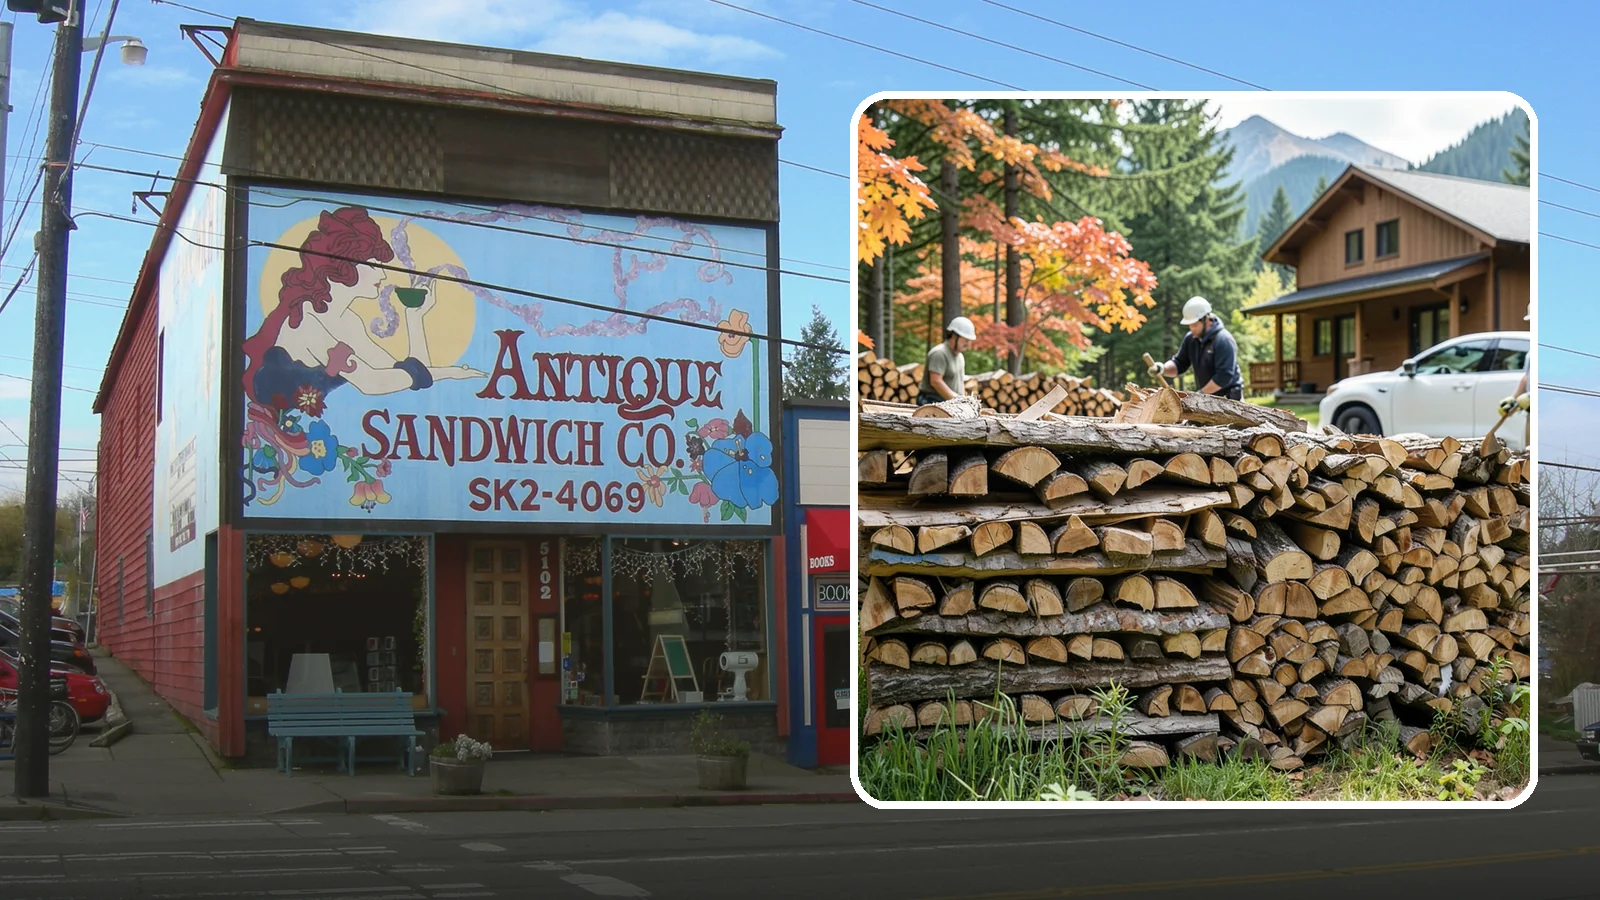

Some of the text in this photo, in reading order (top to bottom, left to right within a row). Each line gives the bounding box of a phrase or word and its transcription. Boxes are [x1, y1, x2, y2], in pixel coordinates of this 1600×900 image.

[475, 329, 723, 421] ANTIQUE
[361, 409, 685, 469] SANDWICH CO.
[468, 477, 645, 513] SK2-4069
[540, 542, 552, 599] 5102
[809, 555, 835, 569] BOOKS
